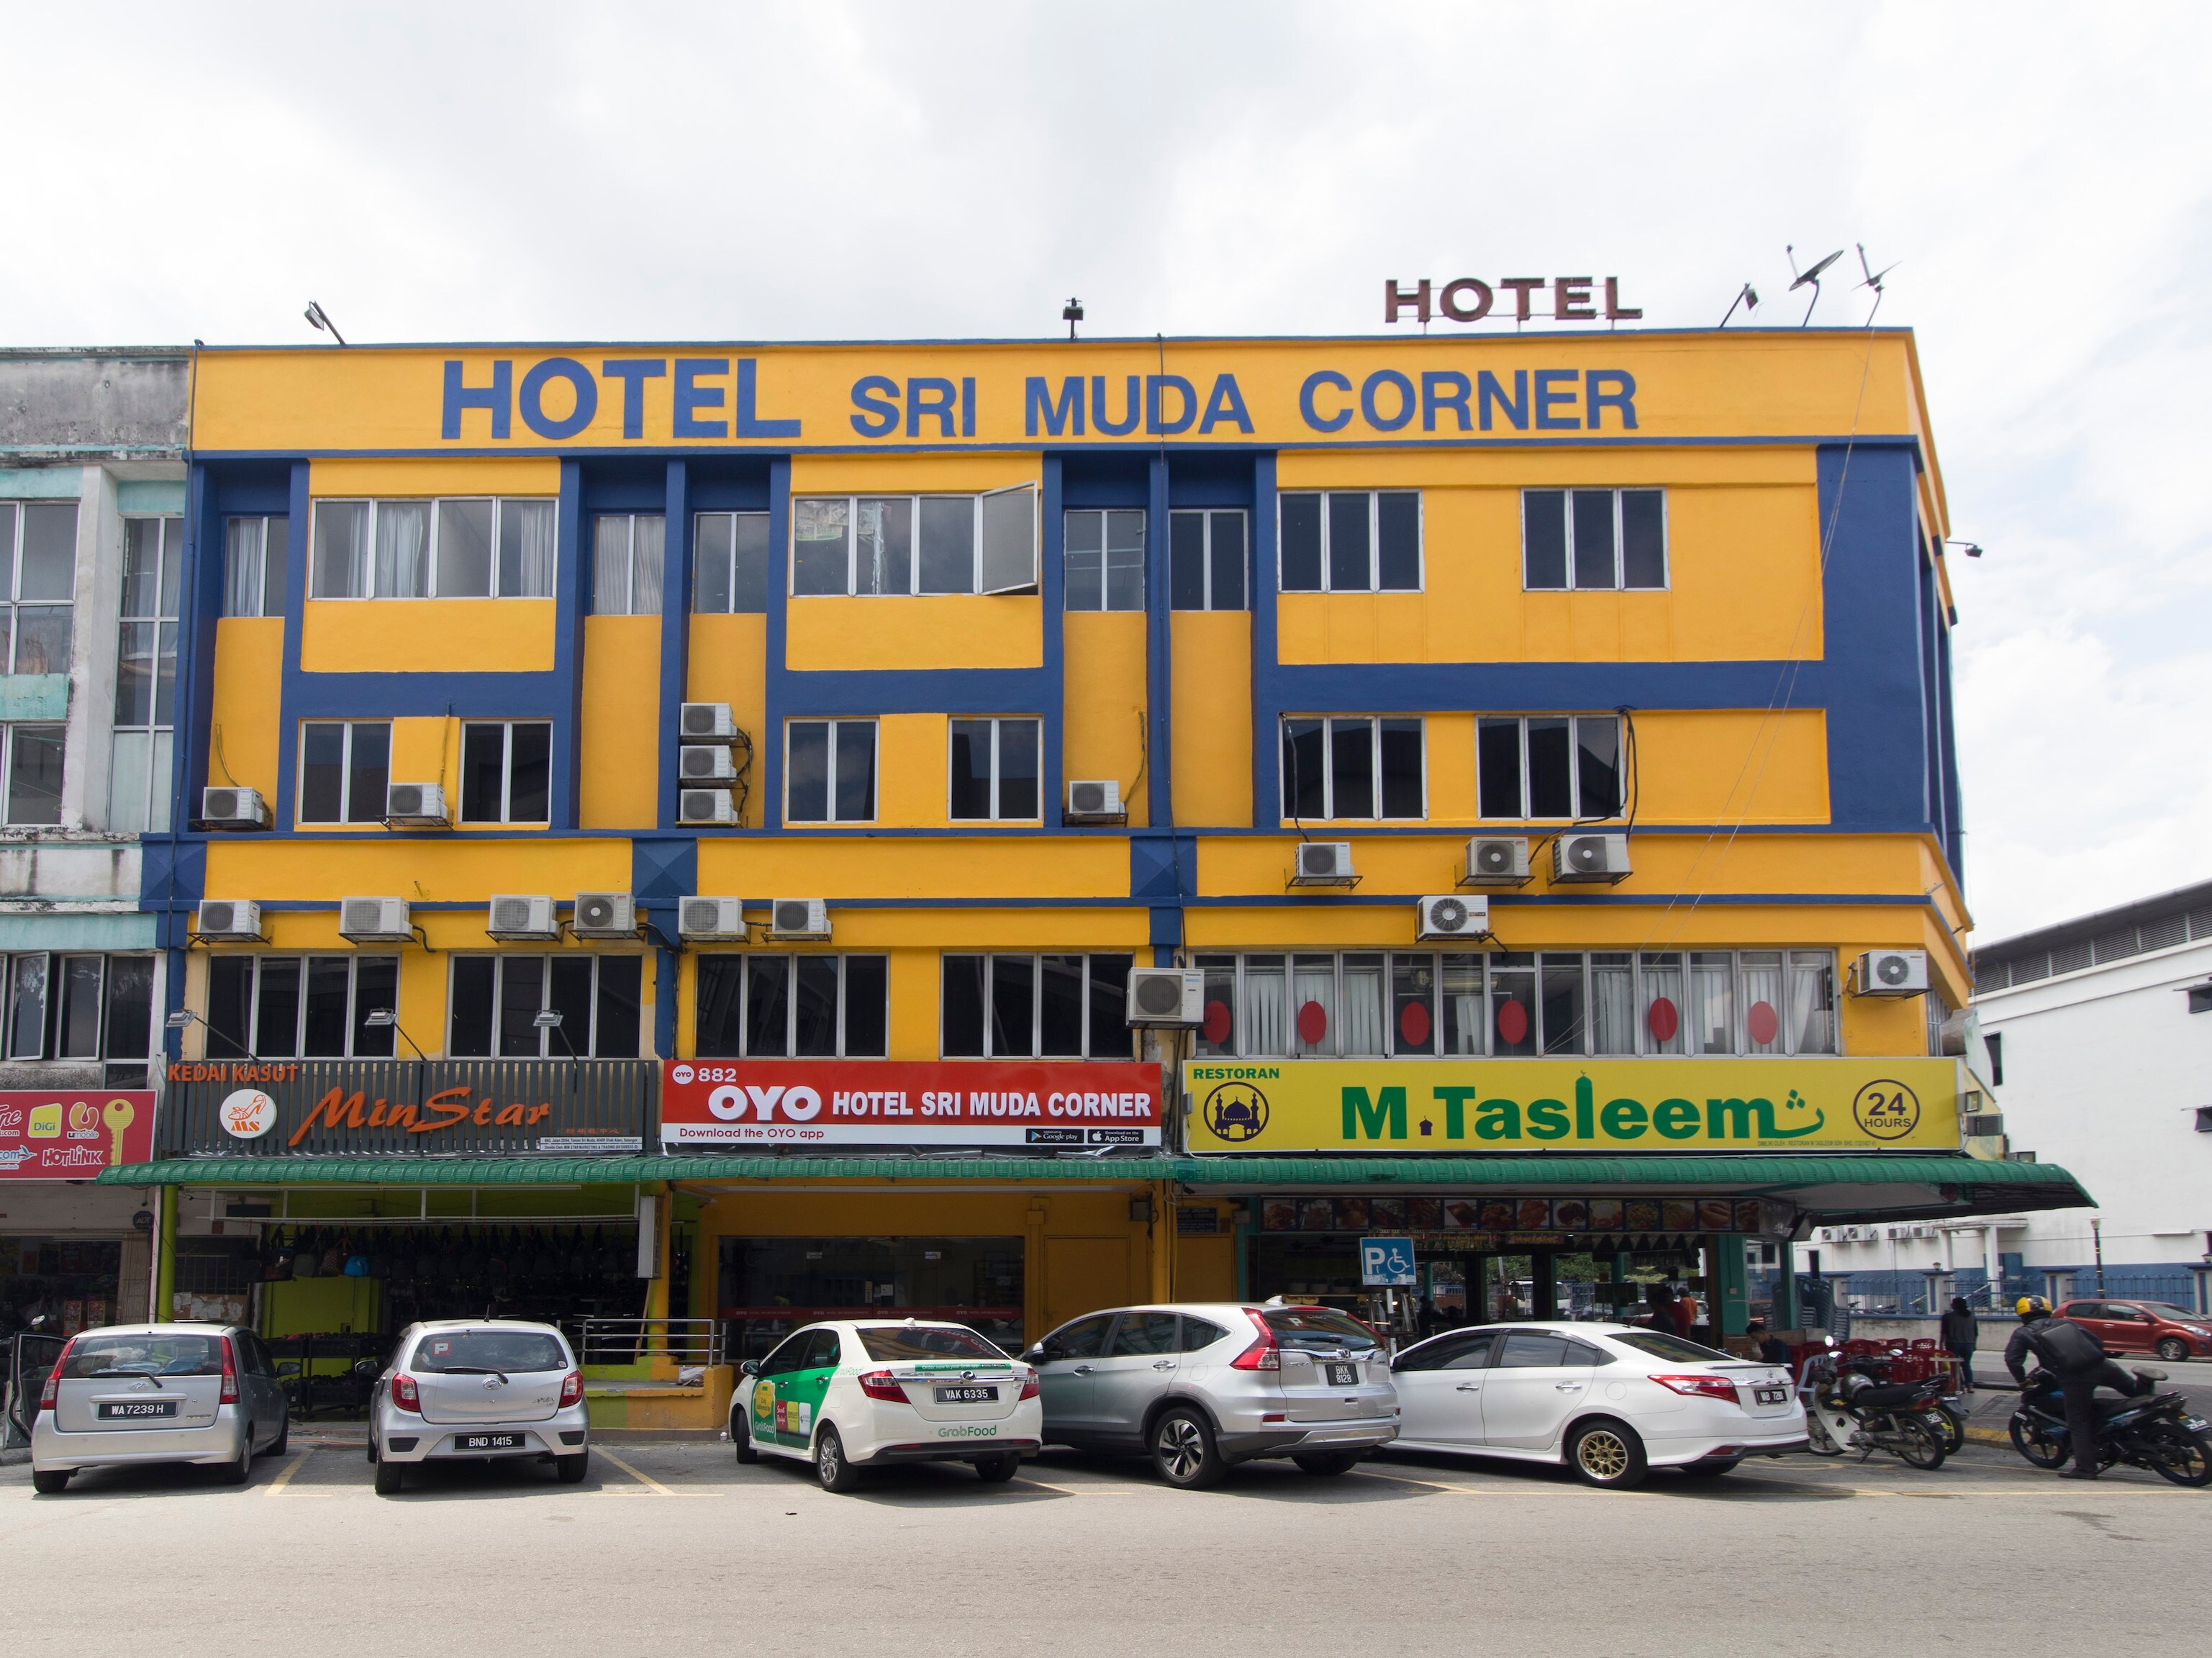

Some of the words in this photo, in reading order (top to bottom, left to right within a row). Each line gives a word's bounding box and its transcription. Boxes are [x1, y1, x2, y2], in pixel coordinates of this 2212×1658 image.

[1385, 277, 1642, 322] HOTEL
[443, 358, 800, 438] HOTEL
[851, 376, 974, 436] SRI
[1026, 375, 1253, 435] MUDA
[1300, 371, 1636, 431] CORNER
[168, 1064, 227, 1082] KEDAI
[233, 1065, 299, 1082] KASUT
[699, 1068, 737, 1082] 882
[1193, 1068, 1279, 1079] RESTORAN
[708, 1084, 822, 1121] OYO
[833, 1091, 913, 1115] HOTEL
[920, 1092, 961, 1115] SRI
[970, 1092, 1041, 1116] MUDA
[1048, 1092, 1152, 1117] CORNER
[1867, 1092, 1907, 1116] 24
[289, 1087, 550, 1146] MinStar
[231, 1121, 260, 1132] MS
[1864, 1118, 1912, 1128] HOURS
[679, 1128, 740, 1138] Download
[745, 1128, 763, 1138] the
[767, 1128, 795, 1138] OYO
[799, 1131, 824, 1140] app
[1365, 1247, 1385, 1274] P
[1288, 1318, 1302, 1326] P
[434, 1342, 449, 1355] P
[1336, 1365, 1349, 1374] BKK
[1336, 1374, 1352, 1383] 8128
[946, 1390, 961, 1399] VAK
[964, 1389, 988, 1398] 6335
[112, 1405, 124, 1415] WA
[125, 1404, 155, 1415] 7239
[156, 1404, 164, 1413] H
[938, 1425, 997, 1437] GrabFood
[468, 1437, 488, 1447] BND
[492, 1436, 512, 1446] 1415
